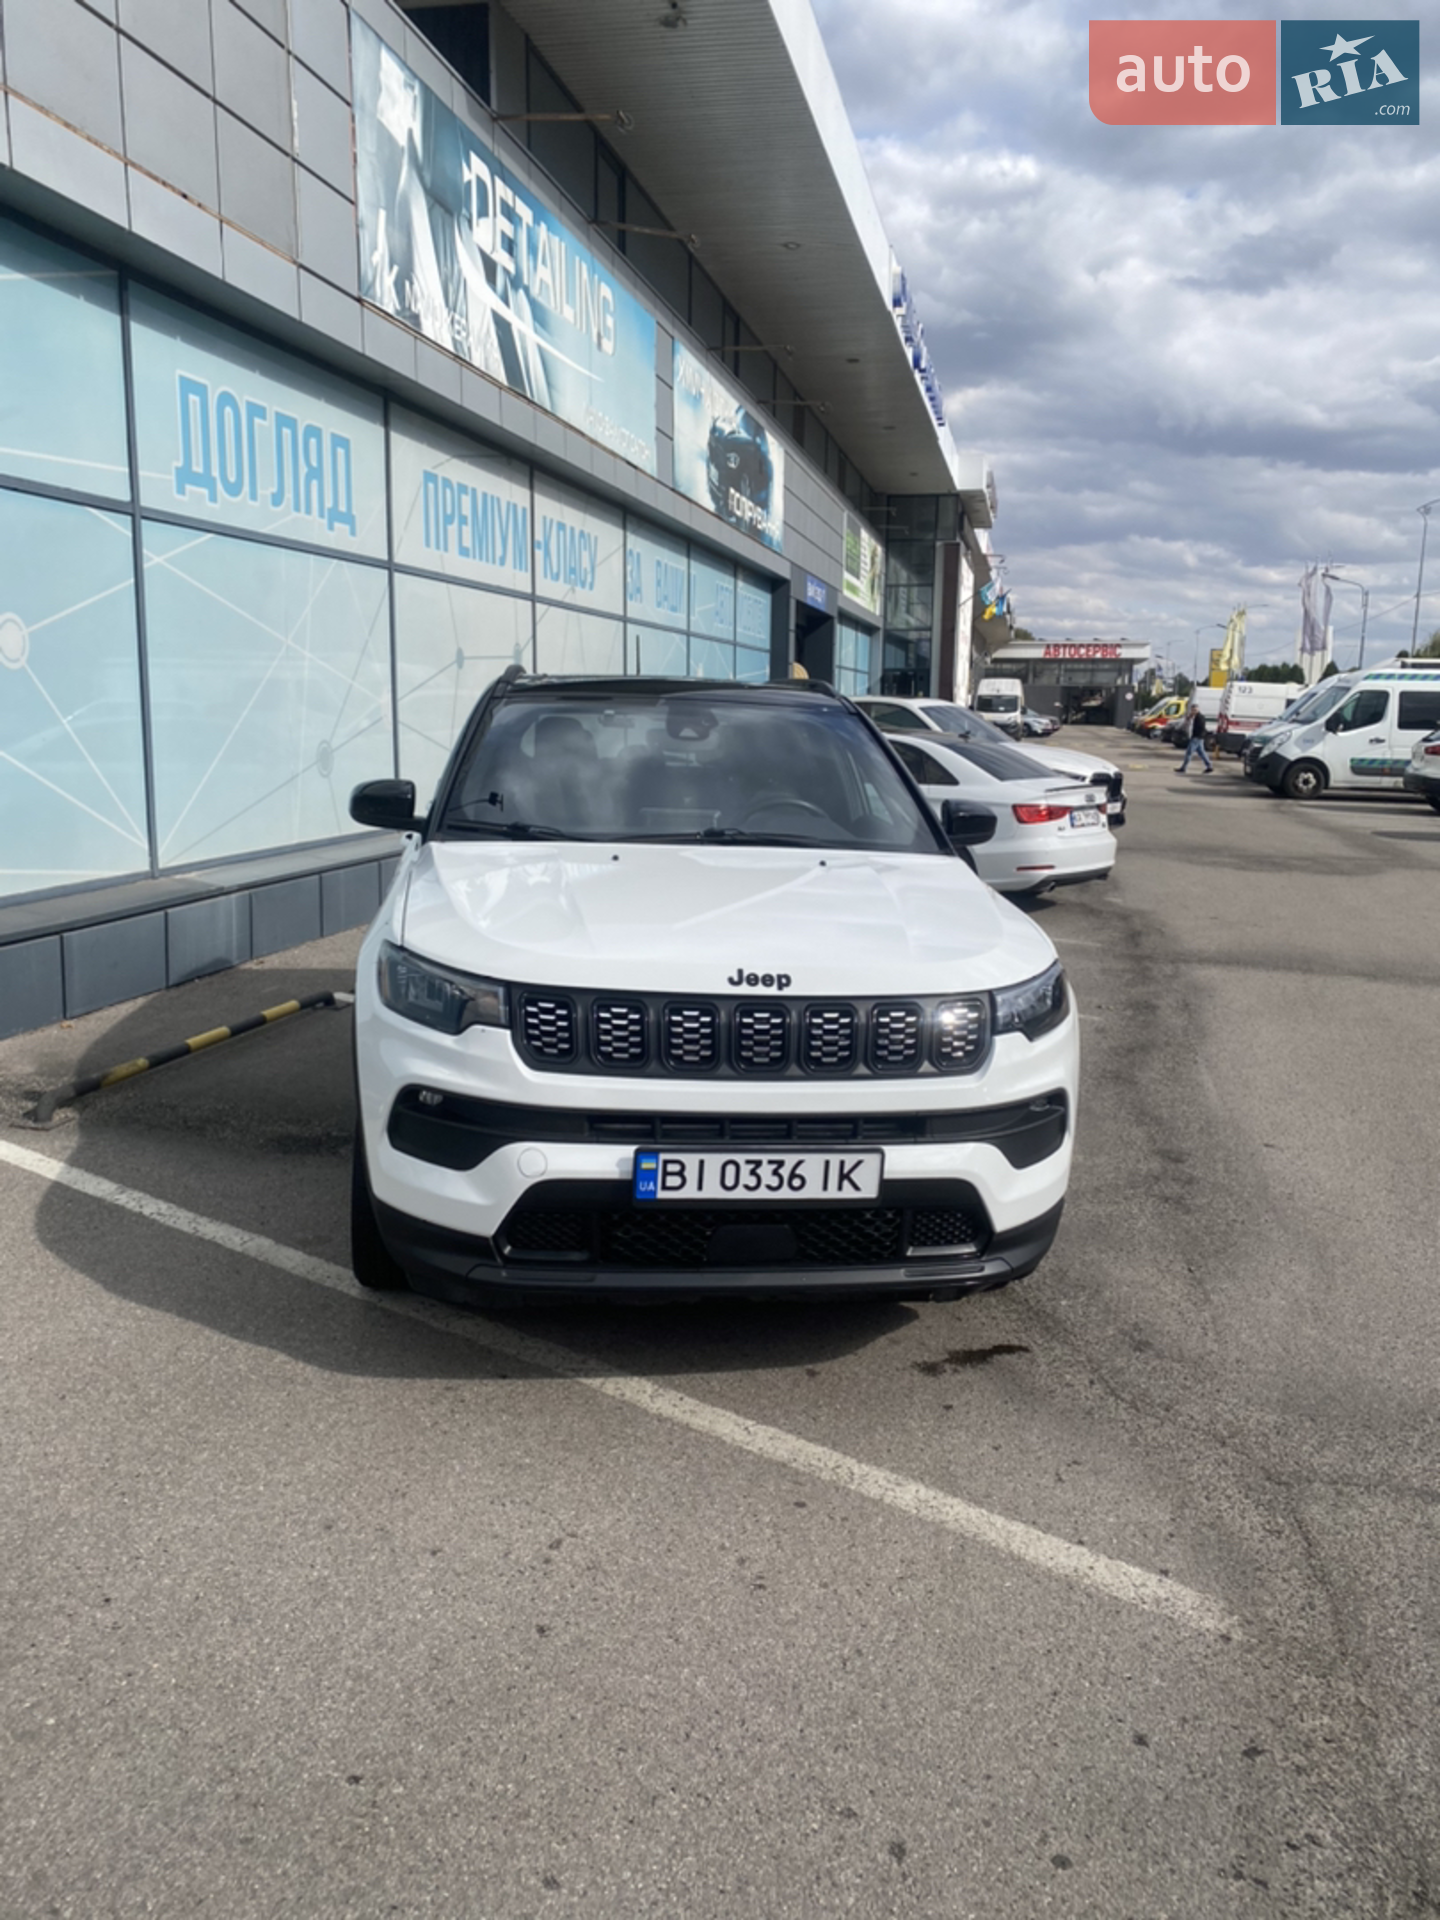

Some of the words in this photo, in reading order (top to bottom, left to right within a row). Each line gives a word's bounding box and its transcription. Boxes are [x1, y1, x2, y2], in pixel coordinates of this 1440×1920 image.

[469, 150, 616, 357] DETAILING
[173, 372, 358, 539] ДОГЛЯД
[626, 547, 643, 604] ЗА
[1043, 642, 1123, 659] АВТОСЕРВІС
[727, 968, 792, 991] Jeep
[638, 1180, 656, 1192] UA
[660, 1158, 705, 1192] BI
[719, 1158, 808, 1192] 0336
[821, 1158, 865, 1192] IK
